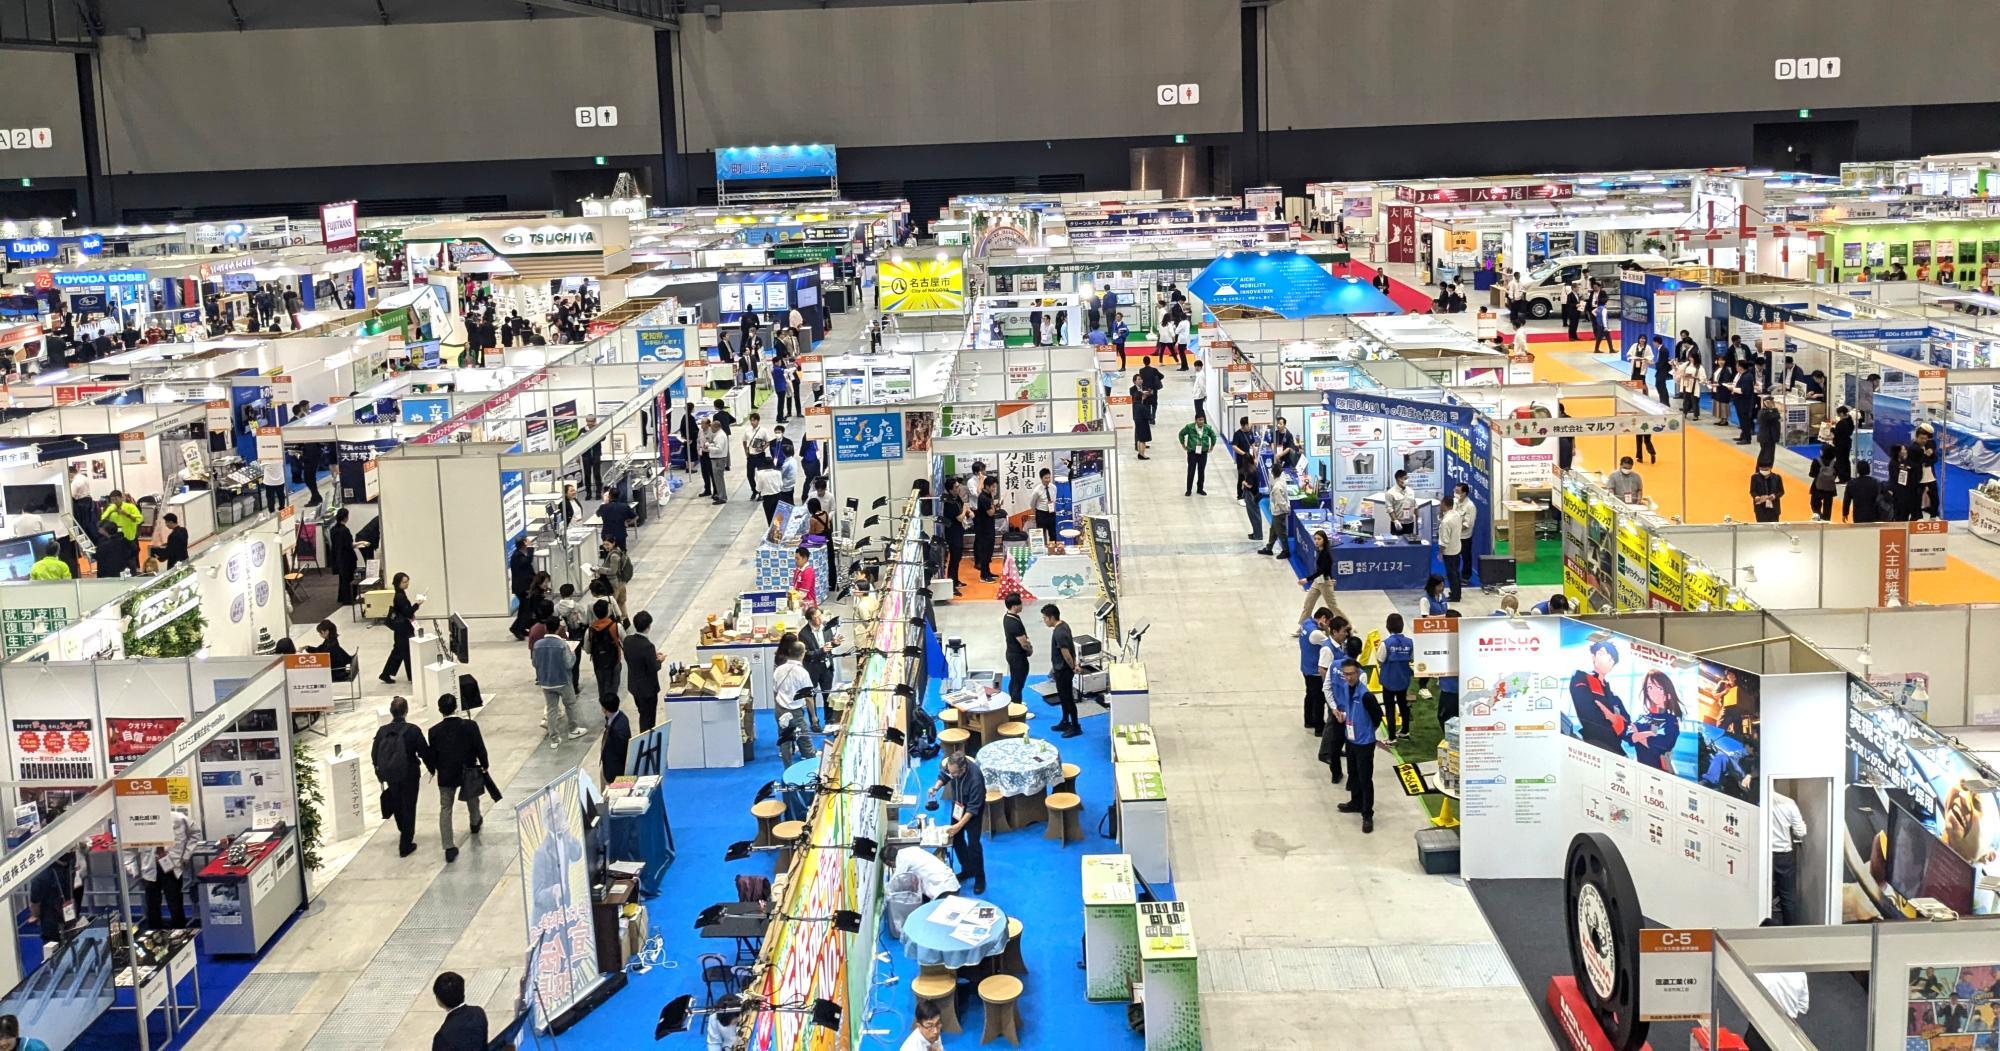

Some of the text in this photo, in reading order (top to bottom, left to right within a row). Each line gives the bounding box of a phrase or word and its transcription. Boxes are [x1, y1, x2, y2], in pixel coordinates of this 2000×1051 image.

[1161, 87, 1173, 102] C
[581, 110, 592, 123] B
[529, 231, 594, 243] TSUCHIYA
[13, 242, 49, 255] Duplo
[55, 273, 106, 285] TOYODA
[909, 277, 951, 288] 名古屋市
[1552, 421, 1615, 433] 株式会社 マルワ
[1885, 541, 1901, 604] 大王製紙
[3, 608, 66, 622] 就労支援
[1423, 620, 1448, 629] C-11
[299, 655, 317, 664] C-3
[128, 722, 164, 730] クオリティに
[130, 780, 152, 790] C-3
[1728, 859, 1734, 875] 1
[1662, 933, 1692, 945] C-5
